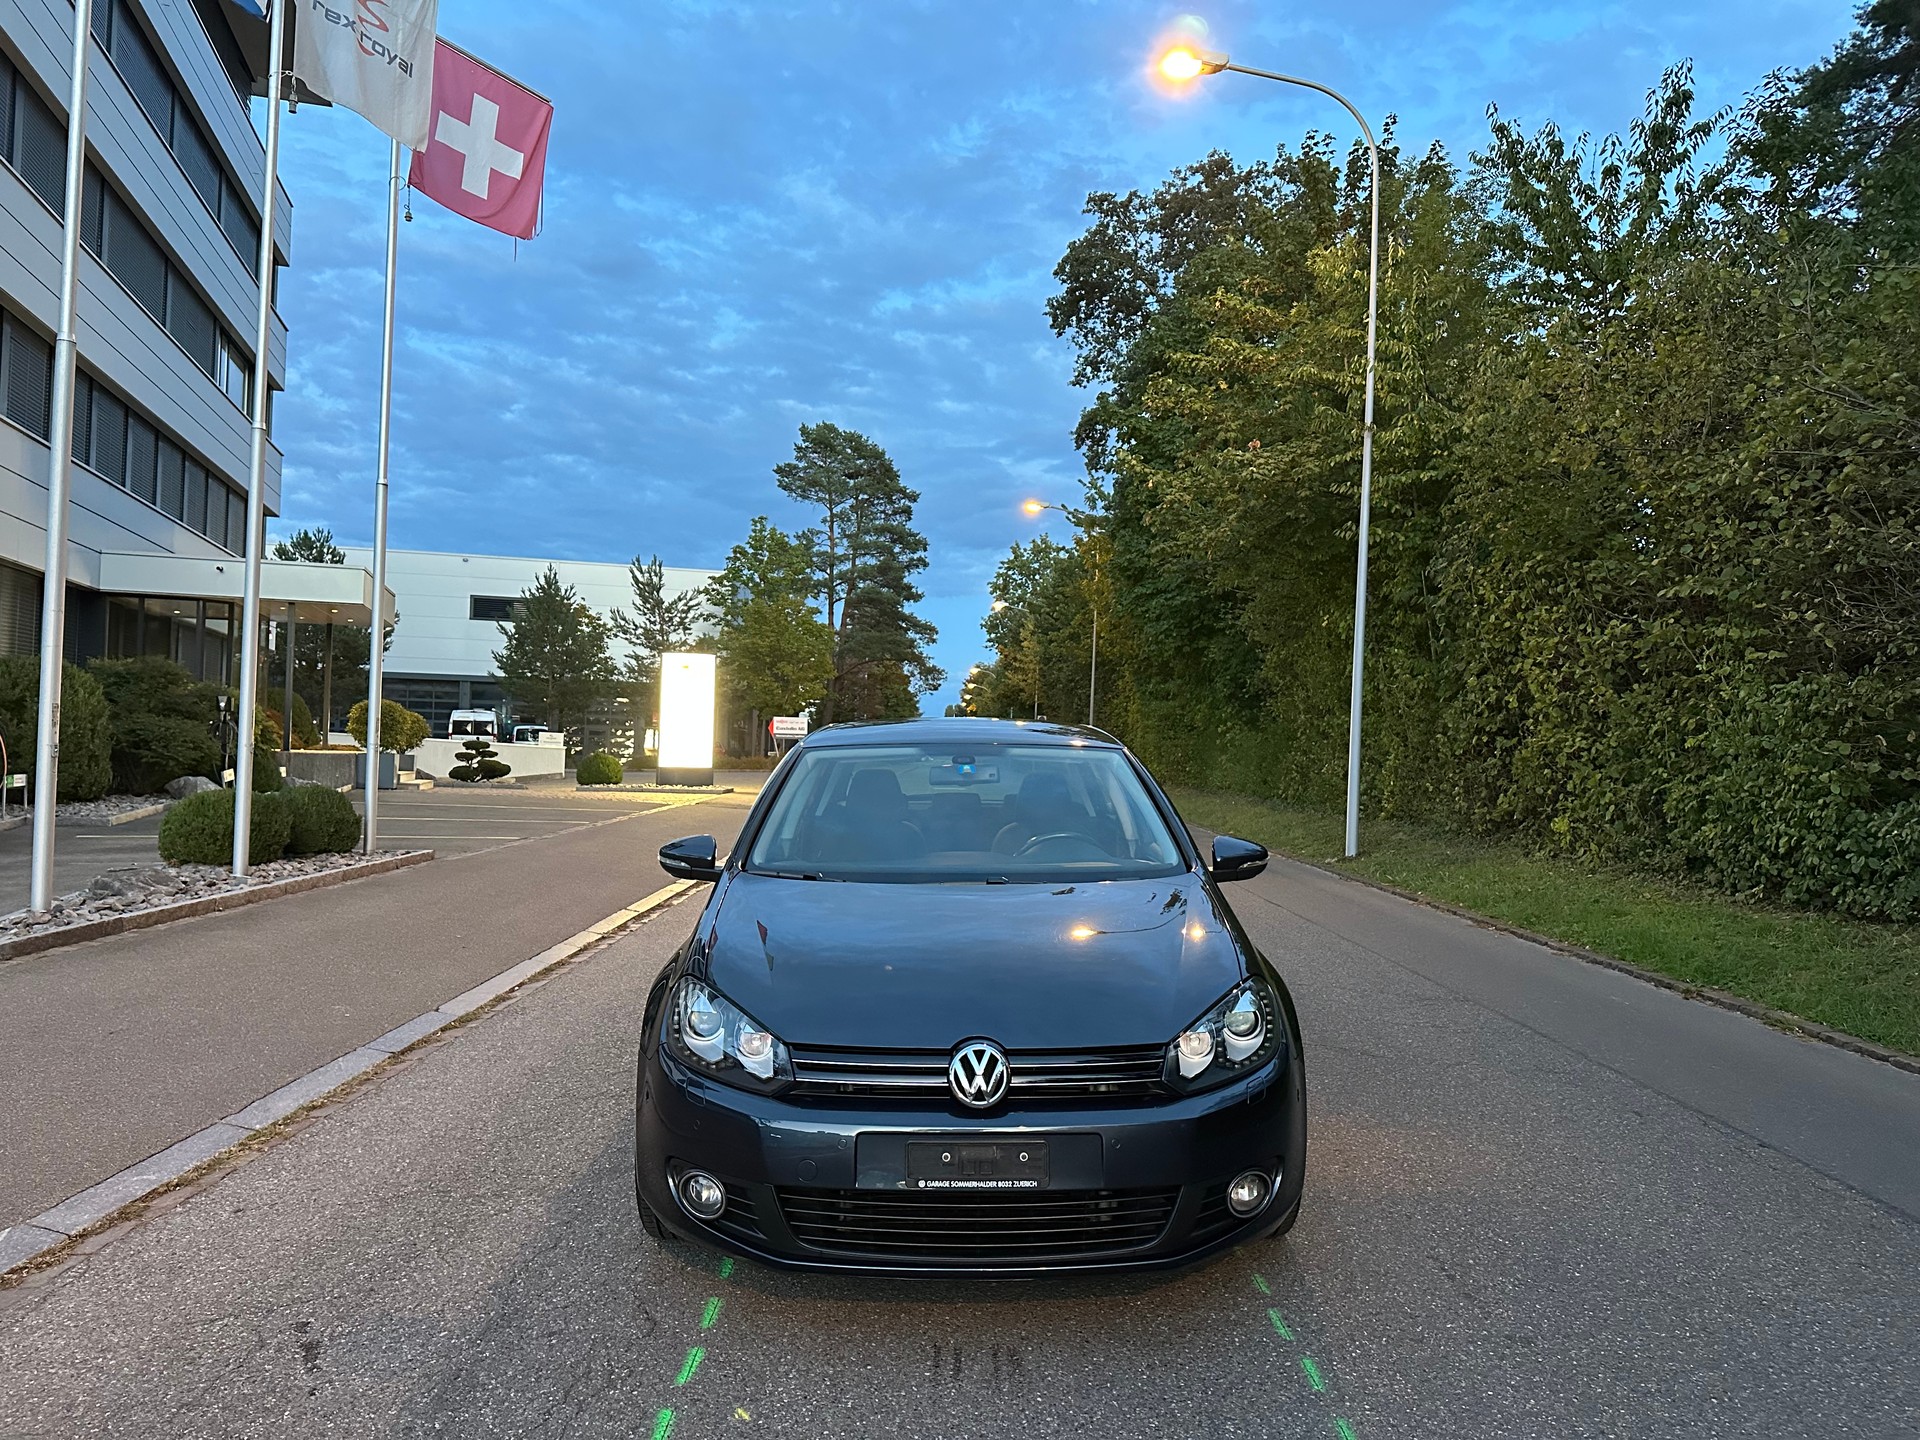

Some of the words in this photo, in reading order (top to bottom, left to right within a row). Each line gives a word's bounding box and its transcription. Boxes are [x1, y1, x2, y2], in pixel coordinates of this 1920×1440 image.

[312, 0, 357, 34] rex
[360, 31, 413, 78] royal
[926, 1180, 950, 1188] GARAGE
[951, 1180, 997, 1188] SOMMERHALDER
[998, 1180, 1012, 1188] 8032
[1013, 1180, 1038, 1188] ZUERICH
